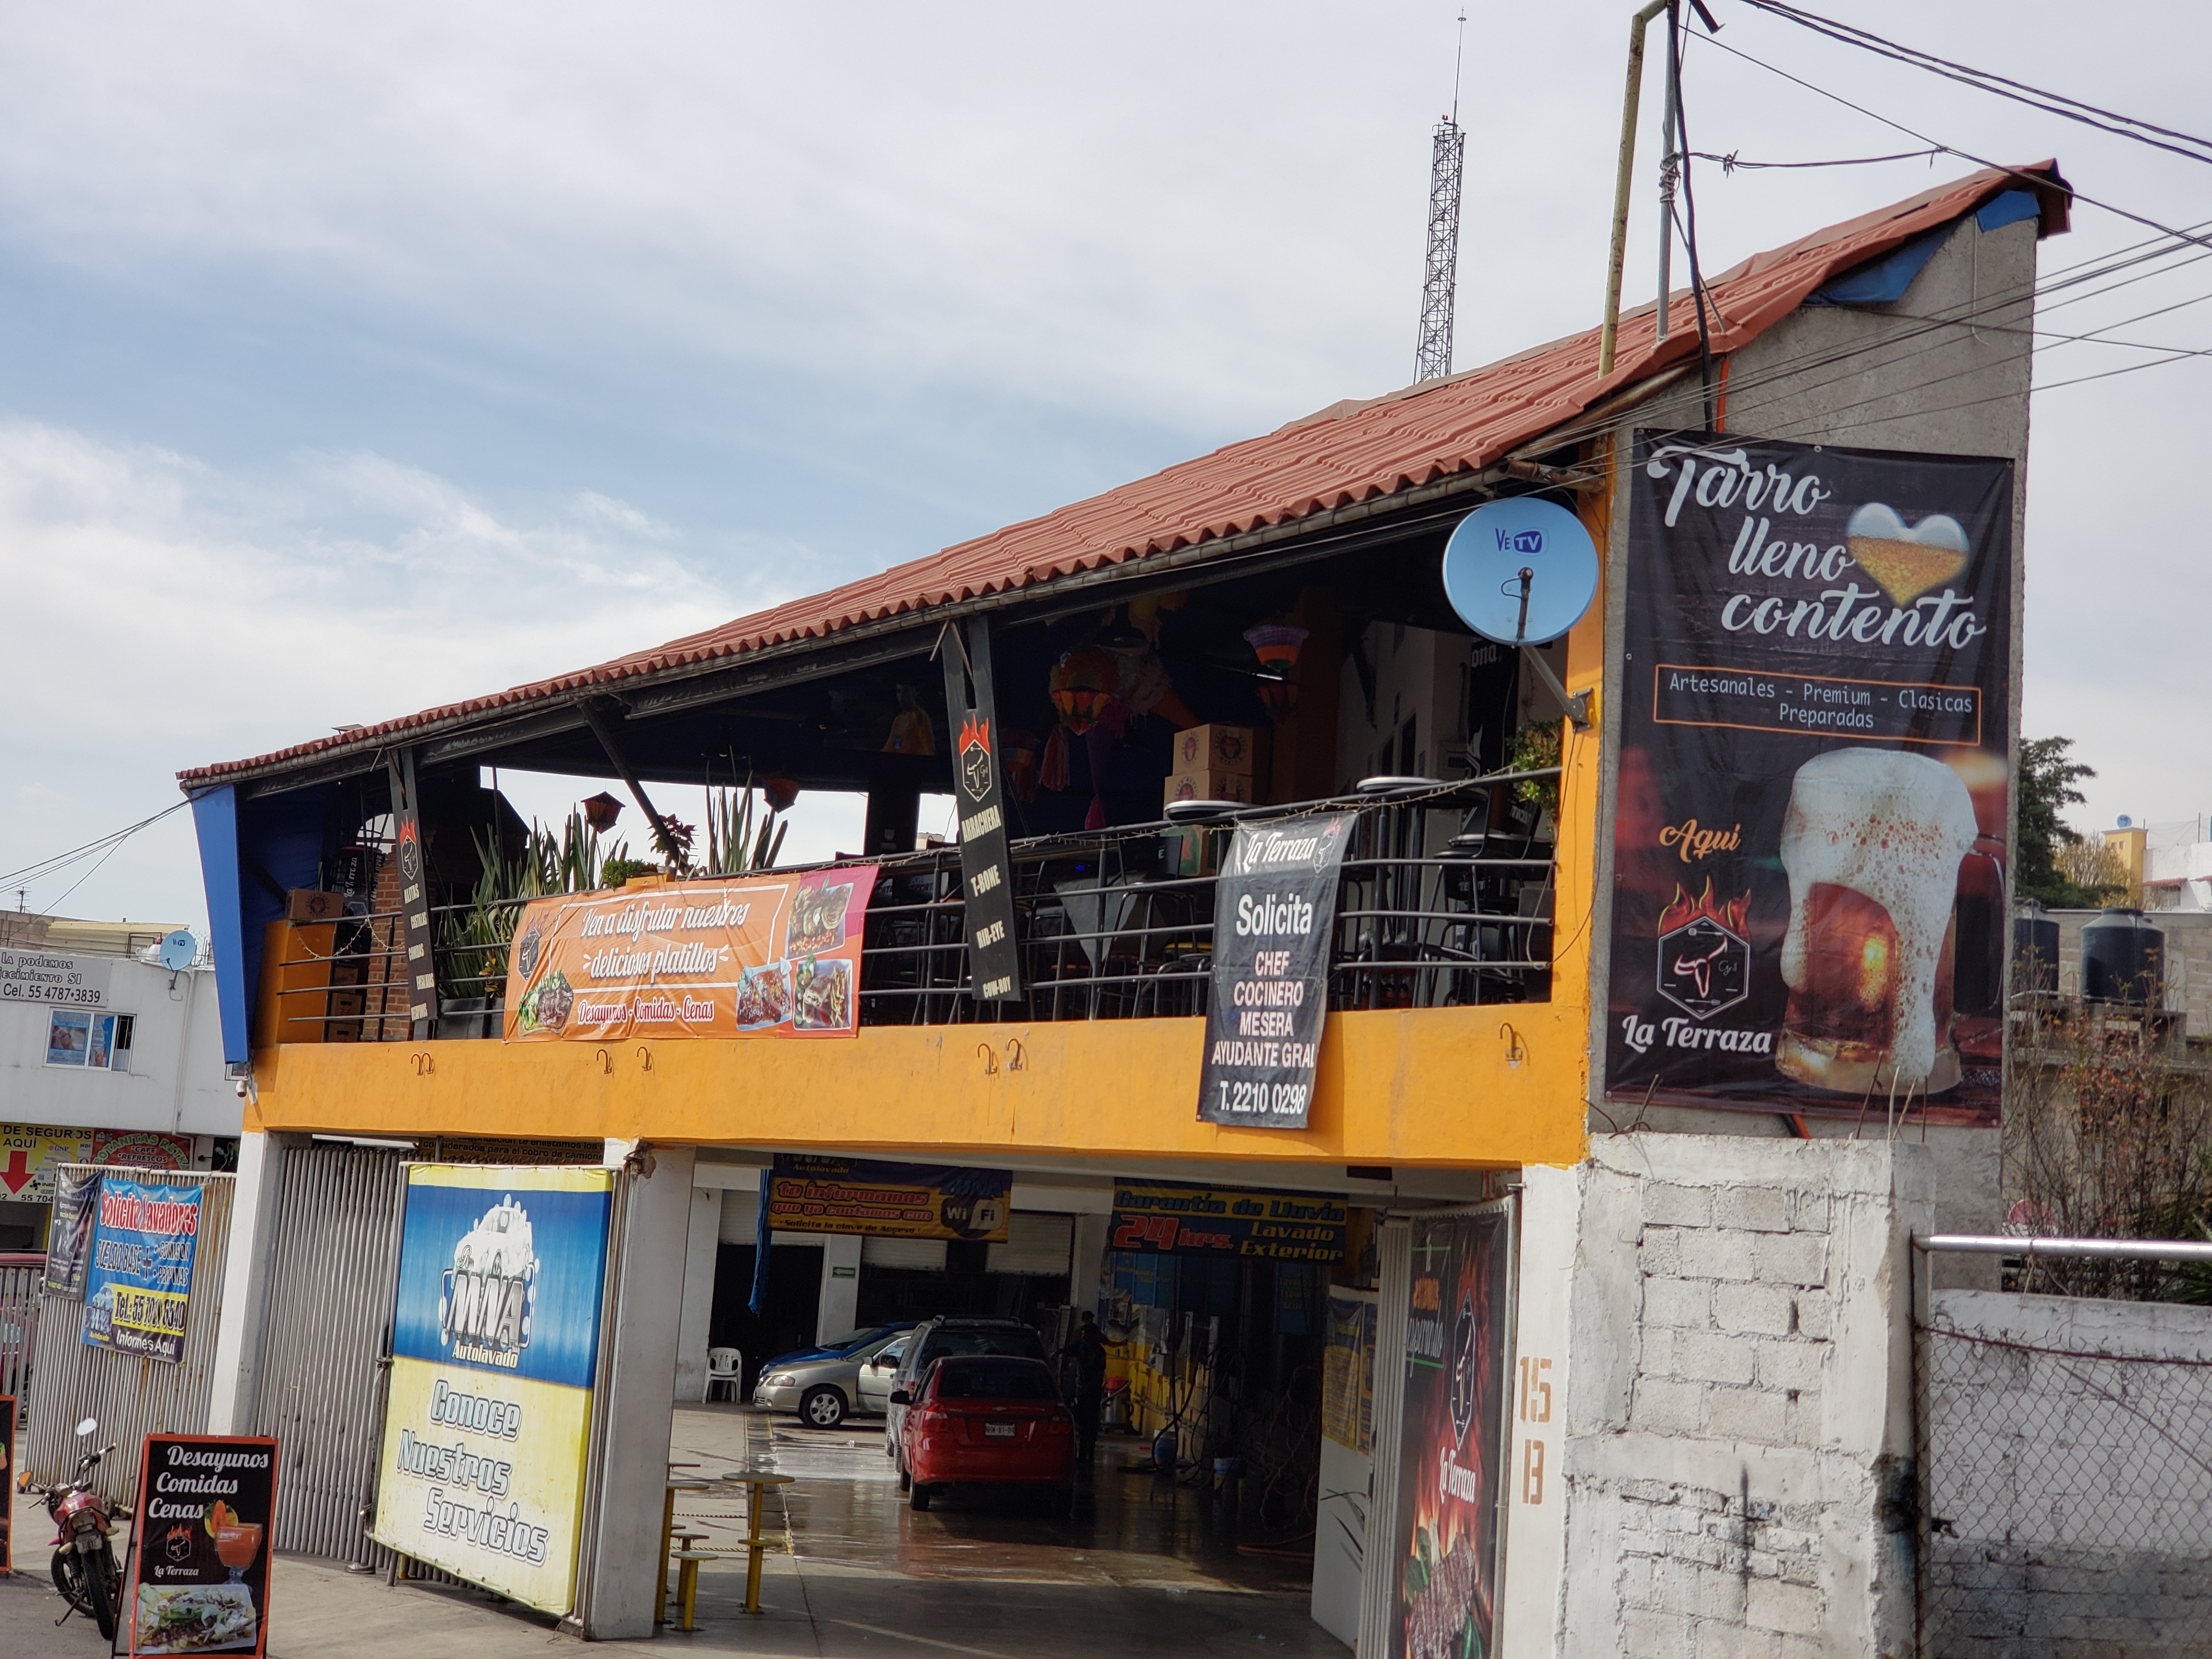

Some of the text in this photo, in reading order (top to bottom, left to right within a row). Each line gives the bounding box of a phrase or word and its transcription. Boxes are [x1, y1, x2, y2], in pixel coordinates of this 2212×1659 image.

[1647, 445, 1831, 527] Tarro
[1728, 516, 1857, 581] lleno
[1720, 583, 1987, 650] contento
[1669, 672, 1776, 698] Artesanales
[1803, 682, 1871, 707] Premium
[1898, 689, 1973, 714] Clasicas
[1779, 703, 1874, 729] Preparadas
[961, 804, 1002, 843] ARRACHERA
[1242, 831, 1319, 872] La Terraza
[404, 883, 420, 904] ALITAS
[970, 864, 1002, 898] T-BONE
[580, 898, 751, 943] Ven a disfrutar nuestros
[1235, 892, 1312, 937] Solicita
[977, 919, 1006, 950] RIB-EYE
[590, 941, 720, 985] deliciosos platillos
[1254, 950, 1290, 978] CHEF
[3, 983, 25, 998] Cel.
[28, 985, 42, 998] 55
[982, 975, 1012, 999] COW-BOY
[1233, 980, 1305, 1008] COCINERO
[633, 995, 676, 1025] Comidas
[682, 994, 715, 1023] Cenas
[1238, 1010, 1295, 1037] MESERA
[1621, 1014, 1773, 1054] La Terraza
[1210, 1040, 1279, 1069] AYUDANTE
[1219, 1080, 1308, 1116] T. 2210 0298
[3, 1125, 22, 1136] DE
[3, 1137, 37, 1149] AQUÍ
[92, 1133, 159, 1165] BOTANITAS
[121, 1153, 168, 1163] REFRESCOS
[487, 1144, 510, 1156] para
[511, 1144, 521, 1155] el
[522, 1146, 549, 1158] cobro
[551, 1148, 563, 1159] de
[583, 1141, 598, 1150] los
[792, 1163, 850, 1175] Autolavado
[777, 1181, 930, 1206] te informamos
[939, 1179, 1004, 1198] ZONA
[771, 1200, 934, 1222] que ya contamos con
[946, 1207, 996, 1222] Wi Fi
[1114, 1189, 1346, 1222] Garantía de Lluvia
[835, 1222, 863, 1232] clave
[864, 1223, 877, 1232] de
[1113, 1214, 1235, 1251] 24 hrs.
[1250, 1220, 1335, 1243] Lavado
[122, 1242, 143, 1276] BASE
[1239, 1239, 1345, 1262] Exterior
[132, 1294, 145, 1325] 55
[116, 1329, 154, 1352] Informes
[452, 1339, 519, 1369] Autolavado
[1519, 1356, 1553, 1423] 15
[429, 1379, 522, 1443] Conoce
[167, 1444, 269, 1473] Desayunos
[396, 1427, 513, 1500] Nuestros
[156, 1471, 239, 1494] Comidas
[1439, 1446, 1476, 1505] La Terraza
[148, 1497, 204, 1519] Cenas
[422, 1487, 551, 1568] Servicios
[154, 1565, 200, 1578] La Terraza
